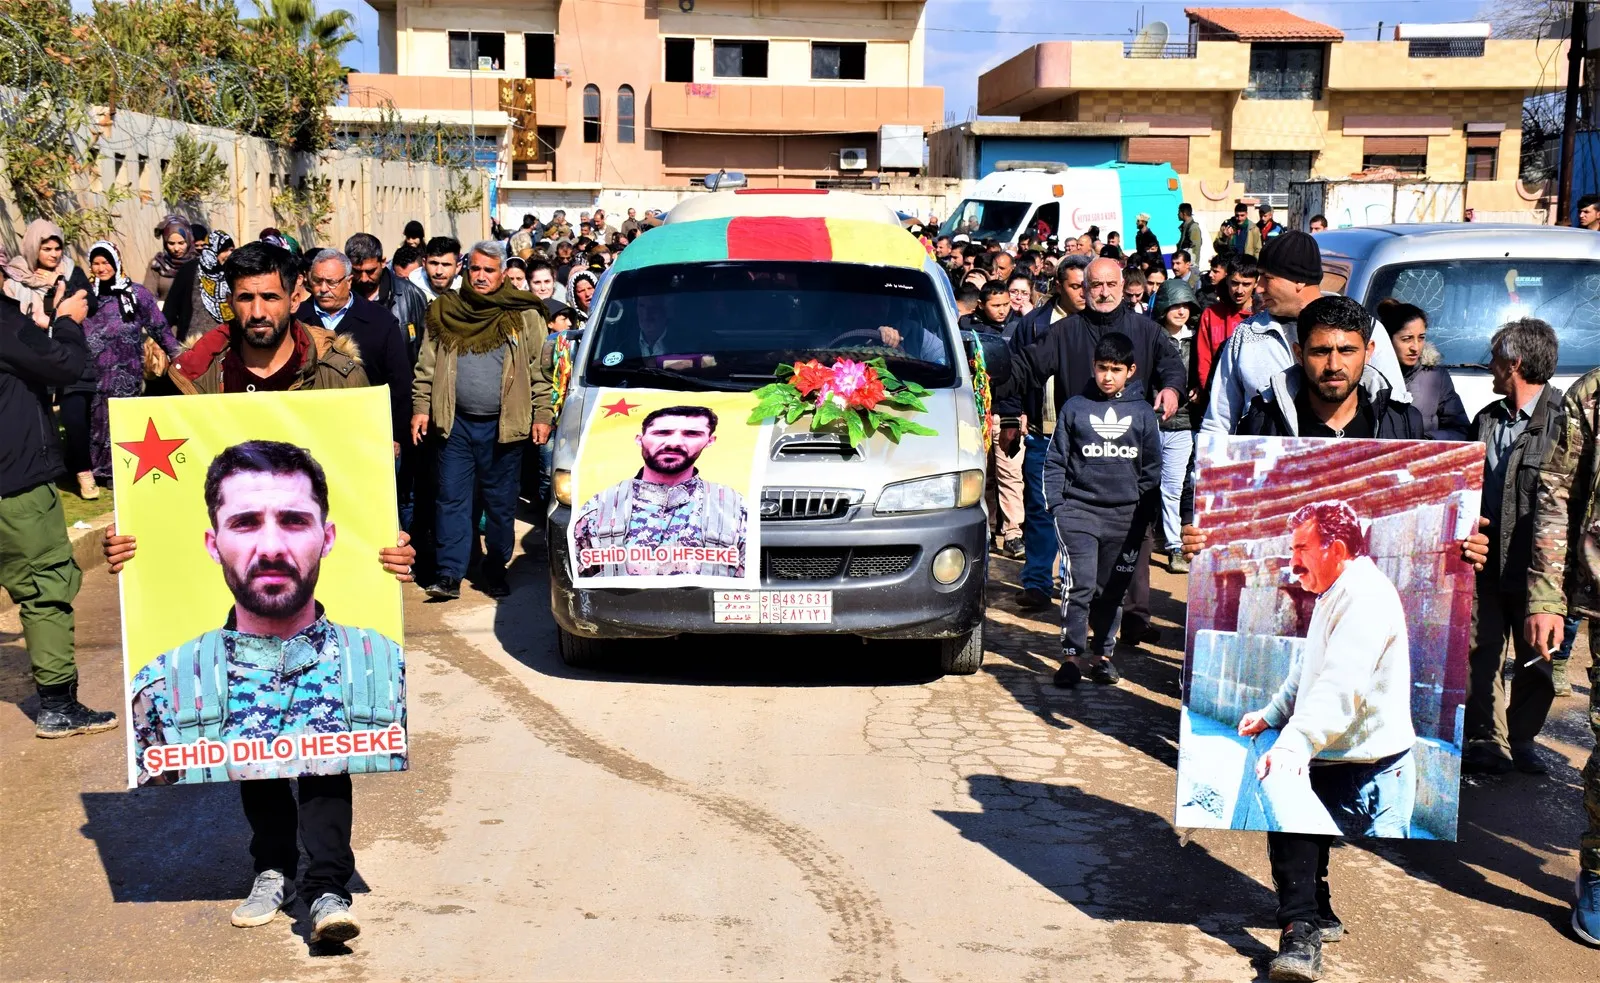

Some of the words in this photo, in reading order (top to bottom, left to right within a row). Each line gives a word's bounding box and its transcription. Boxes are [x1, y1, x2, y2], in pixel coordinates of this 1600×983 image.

[1082, 441, 1138, 458] abibas
[630, 548, 668, 562] DILO
[782, 593, 828, 606] 482631
[782, 609, 827, 621] ٤٨٢٦٣١
[147, 741, 226, 772] ŞEHÎD
[233, 739, 294, 762] DILO
[301, 727, 405, 757] HESEKÊ
